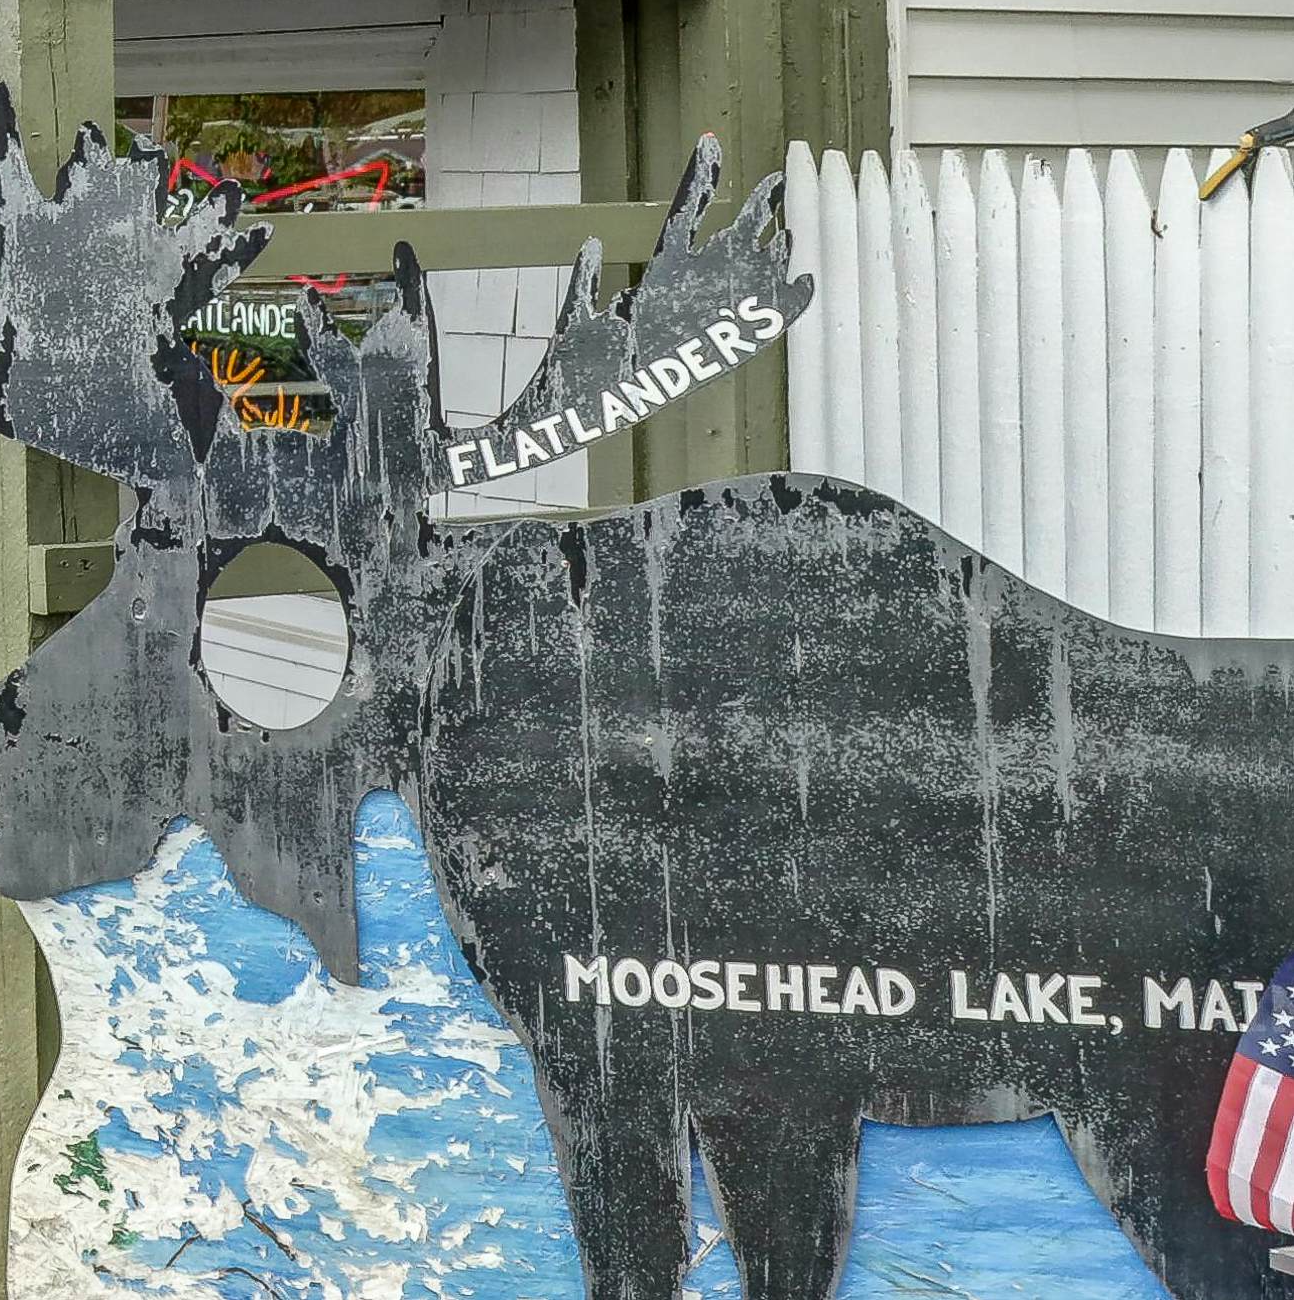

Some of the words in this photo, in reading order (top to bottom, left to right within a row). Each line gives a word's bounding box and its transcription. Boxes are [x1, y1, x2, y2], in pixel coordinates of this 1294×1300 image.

[180, 299, 296, 339] ATLANDE
[445, 295, 785, 486] FLATLANDER'S
[562, 952, 916, 1017] MOOSEHEAD
[950, 969, 1123, 1037] LAKE,
